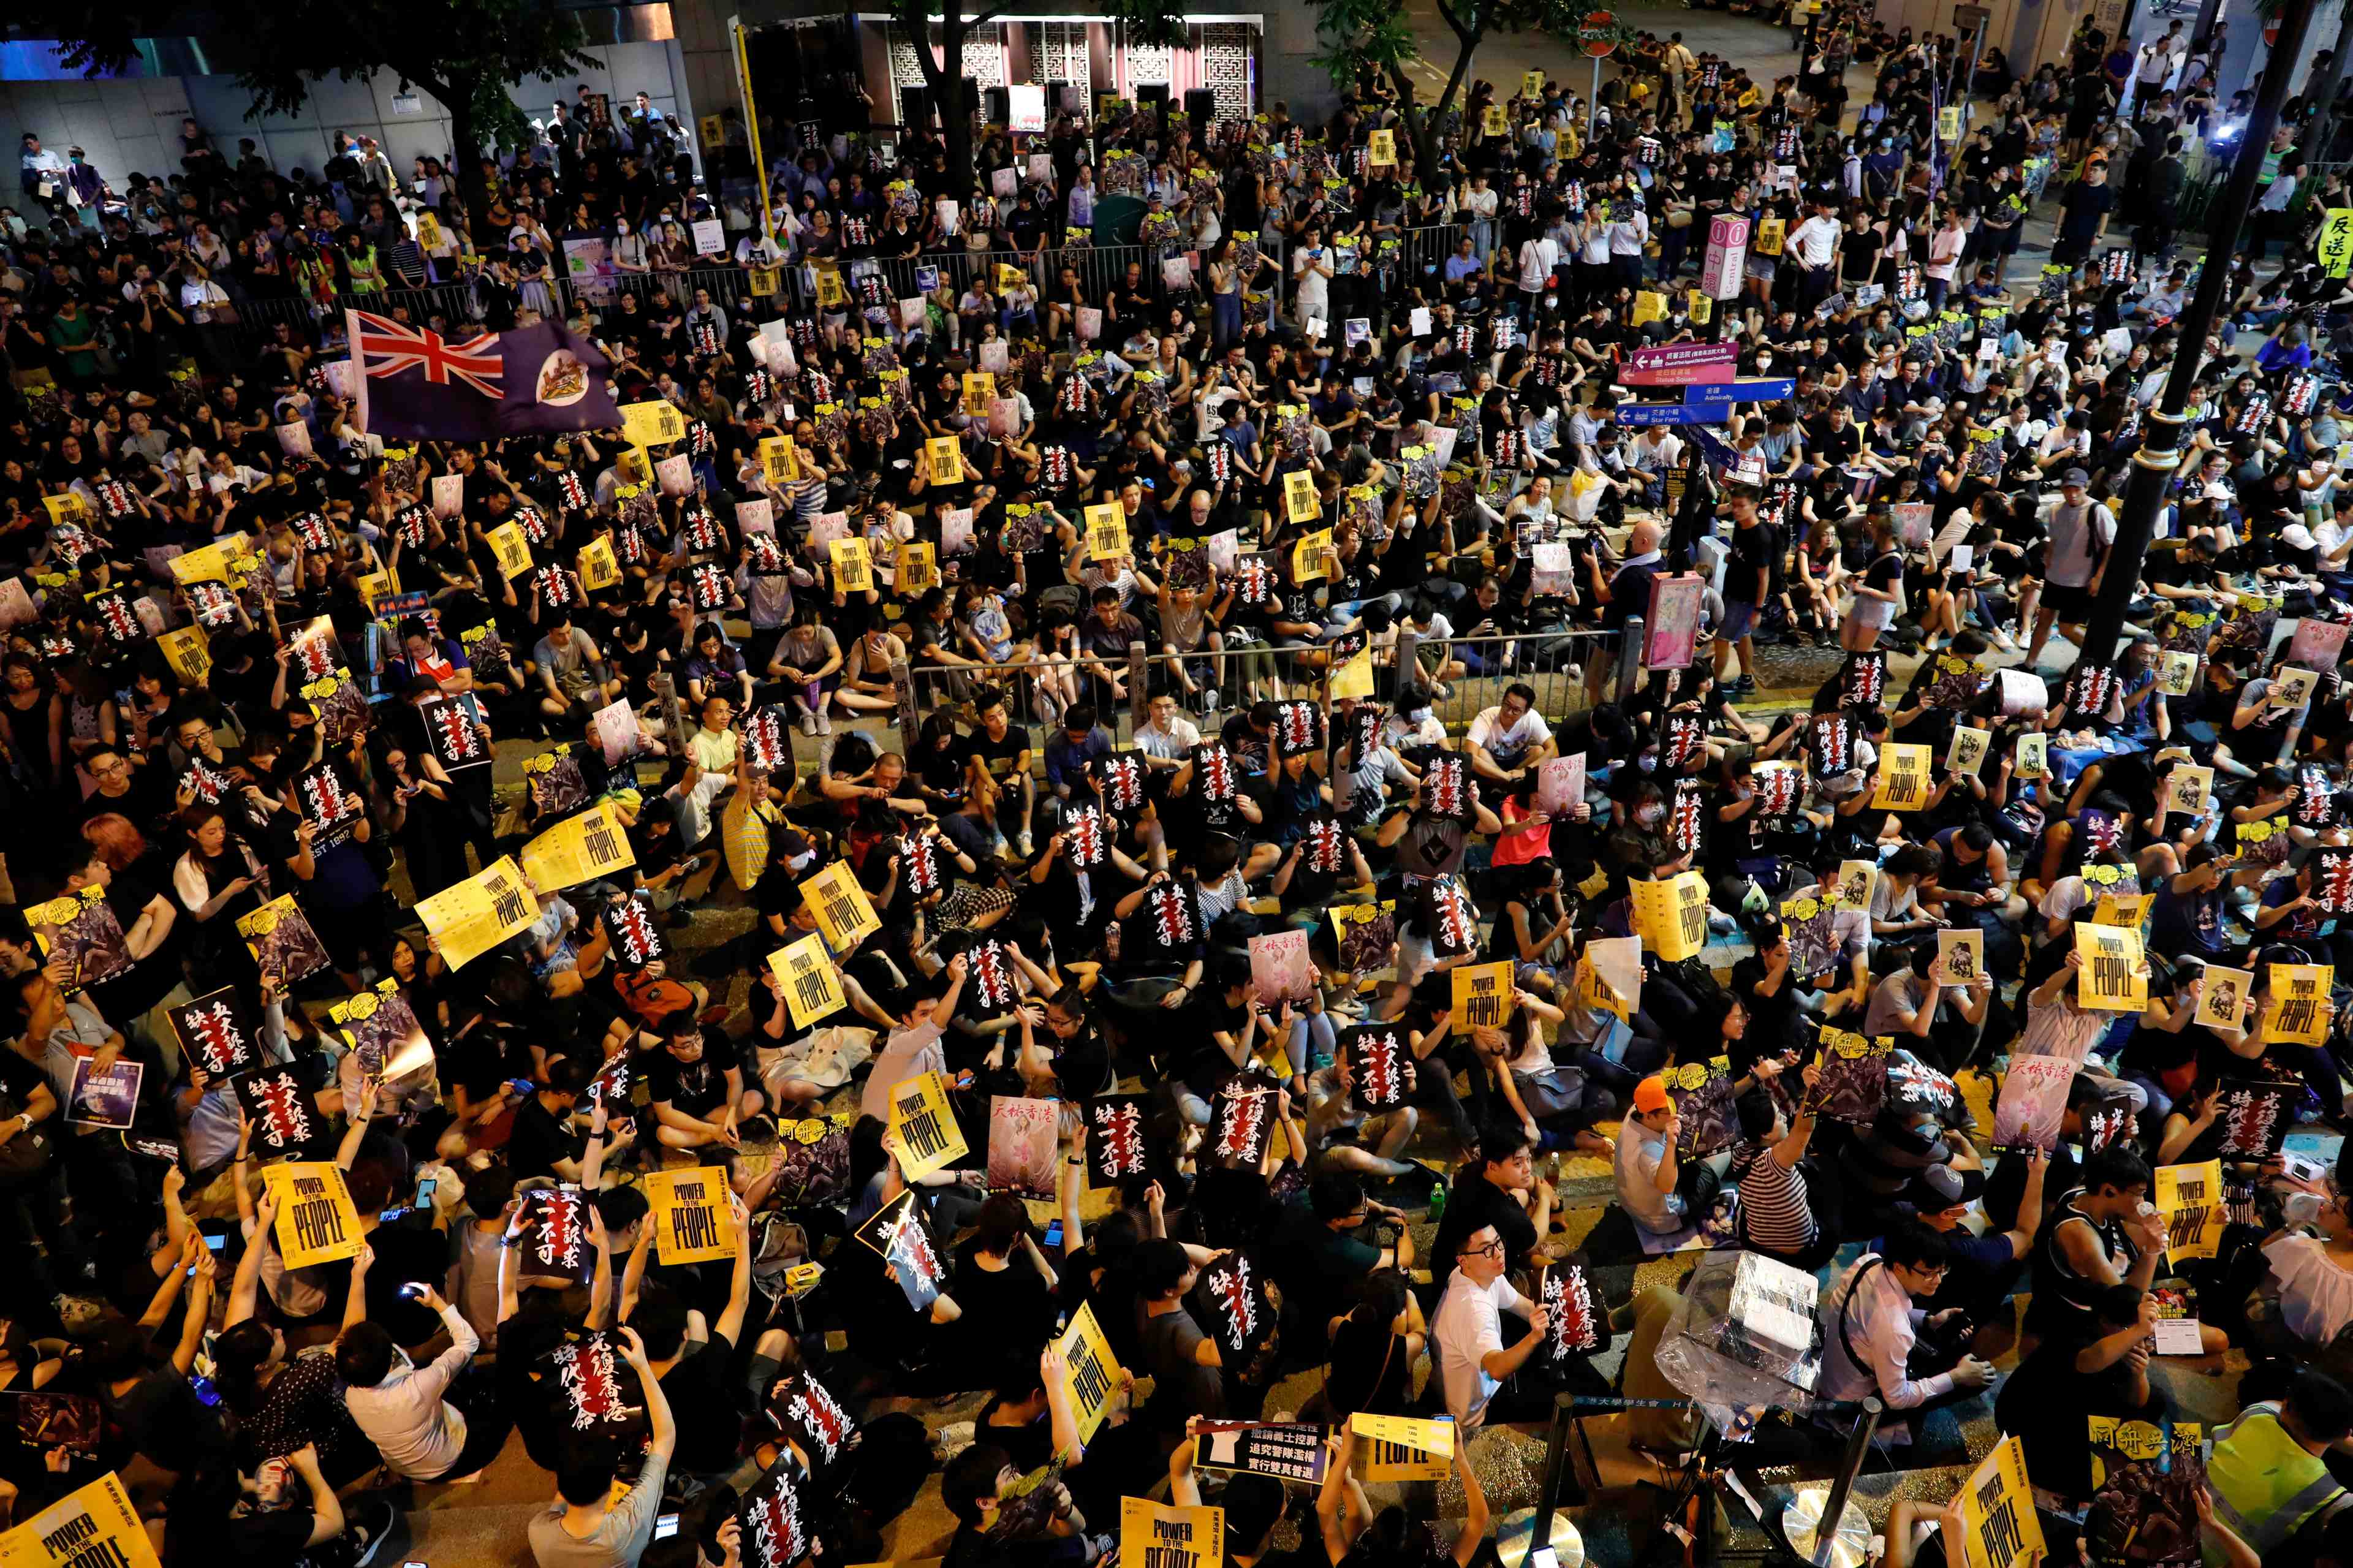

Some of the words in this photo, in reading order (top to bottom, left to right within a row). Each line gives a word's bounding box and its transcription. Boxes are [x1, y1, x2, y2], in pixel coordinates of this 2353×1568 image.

[2324, 216, 2350, 276] 反送中
[1725, 252, 1738, 294] Central
[1097, 513, 1113, 525] POWER
[1097, 525, 1121, 551] PEOPLE
[434, 707, 459, 760] 缺一不可
[453, 702, 479, 757] 五大訴求
[1278, 704, 1295, 751] 時代革命
[1297, 702, 1314, 748] 光復香港
[1106, 757, 1123, 810] 缺一不可
[1125, 755, 1141, 807] 五大訴求
[1201, 747, 1216, 801] 缺一不可
[1217, 744, 1233, 799] 五大訴求
[1887, 773, 1919, 802] PEOPLE
[1896, 756, 1915, 769] POWER
[303, 774, 330, 830] 時代革命
[322, 764, 349, 820] 光復香港
[330, 829, 350, 849] 1892
[583, 816, 604, 828] POWER
[584, 828, 621, 867] PEOPLE
[1067, 809, 1085, 867] 缺一不可
[1085, 804, 1104, 865] 五大訴求
[1309, 820, 1324, 873] 缺一不可
[1327, 819, 1342, 872] 五大訴求
[1676, 793, 1687, 851] 缺一不可
[1686, 793, 1700, 850] 五大訴求
[484, 876, 509, 896] POWER
[901, 839, 922, 893] 缺一不可
[921, 833, 939, 888] 五大訴求
[492, 887, 528, 928] PEOPLE
[819, 879, 842, 900] POWER
[824, 892, 865, 937] PEOPLE
[1172, 882, 1193, 942] 五大訴求
[1678, 885, 1699, 899] POWER
[612, 910, 642, 963] 缺一不可
[632, 900, 663, 956] 五大訴求
[1151, 888, 1171, 947] 缺一不可
[1680, 903, 1705, 945] PEOPLE
[790, 952, 813, 971] POWER
[2097, 937, 2124, 952] POWER
[795, 968, 832, 1013] PEOPLE
[970, 944, 991, 1008] 缺一不可
[986, 939, 1010, 1004] 五大訴求
[1471, 977, 1495, 992] POWER
[2093, 957, 2132, 998] PEOPLE
[2291, 980, 2316, 994] POWER
[212, 1001, 248, 1064] 五大訴求
[1467, 994, 1501, 1026] PEOPLE
[2275, 999, 2318, 1034] PEOPLE
[186, 1010, 225, 1072] 缺一不可
[1358, 1034, 1378, 1104] 缺一不可
[1382, 1032, 1400, 1103] 五大訴求
[2014, 1061, 2071, 1080] 天祐香港
[248, 1078, 284, 1147] 缺一不可
[278, 1072, 312, 1142] 五大訴求
[895, 1093, 924, 1116] POWER
[993, 1104, 1055, 1122] 天祐香港
[898, 1108, 947, 1162] PEOPLE
[1095, 1102, 1120, 1178] 缺一不可
[1121, 1101, 1146, 1174] 五大訴求
[293, 1177, 325, 1197] POWER
[675, 1183, 705, 1200] POWER
[2177, 1180, 2205, 1200] POWER
[292, 1197, 347, 1252] PEOPLE
[672, 1206, 719, 1251] PEOPLE
[2171, 1206, 2212, 1249] PEOPLE
[1205, 1269, 1240, 1351] 缺一不可
[1234, 1256, 1254, 1336] 五大訴求
[1544, 1274, 1571, 1360] 時代革命
[1569, 1265, 1599, 1348] 光復香港
[589, 1331, 626, 1422] 光復香港
[1066, 1334, 1088, 1371] POWER
[552, 1344, 596, 1431] 時代革命
[803, 1369, 855, 1442] 光復香港
[1073, 1348, 1113, 1418] PEOPLE
[789, 1395, 839, 1466] 時代革命
[1249, 1442, 1317, 1463] 追究警隊濫權
[1250, 1428, 1318, 1447] 撤銷義士控罪
[2091, 1425, 2200, 1457] 同舟共濟
[1248, 1458, 1314, 1480] 實行雙真普選
[1976, 1472, 2003, 1513] POWER
[41, 1513, 99, 1559] POWER
[1153, 1518, 1193, 1543] POWER
[1172, 1539, 1184, 1548] THE
[1979, 1496, 2024, 1563] PEOPLE
